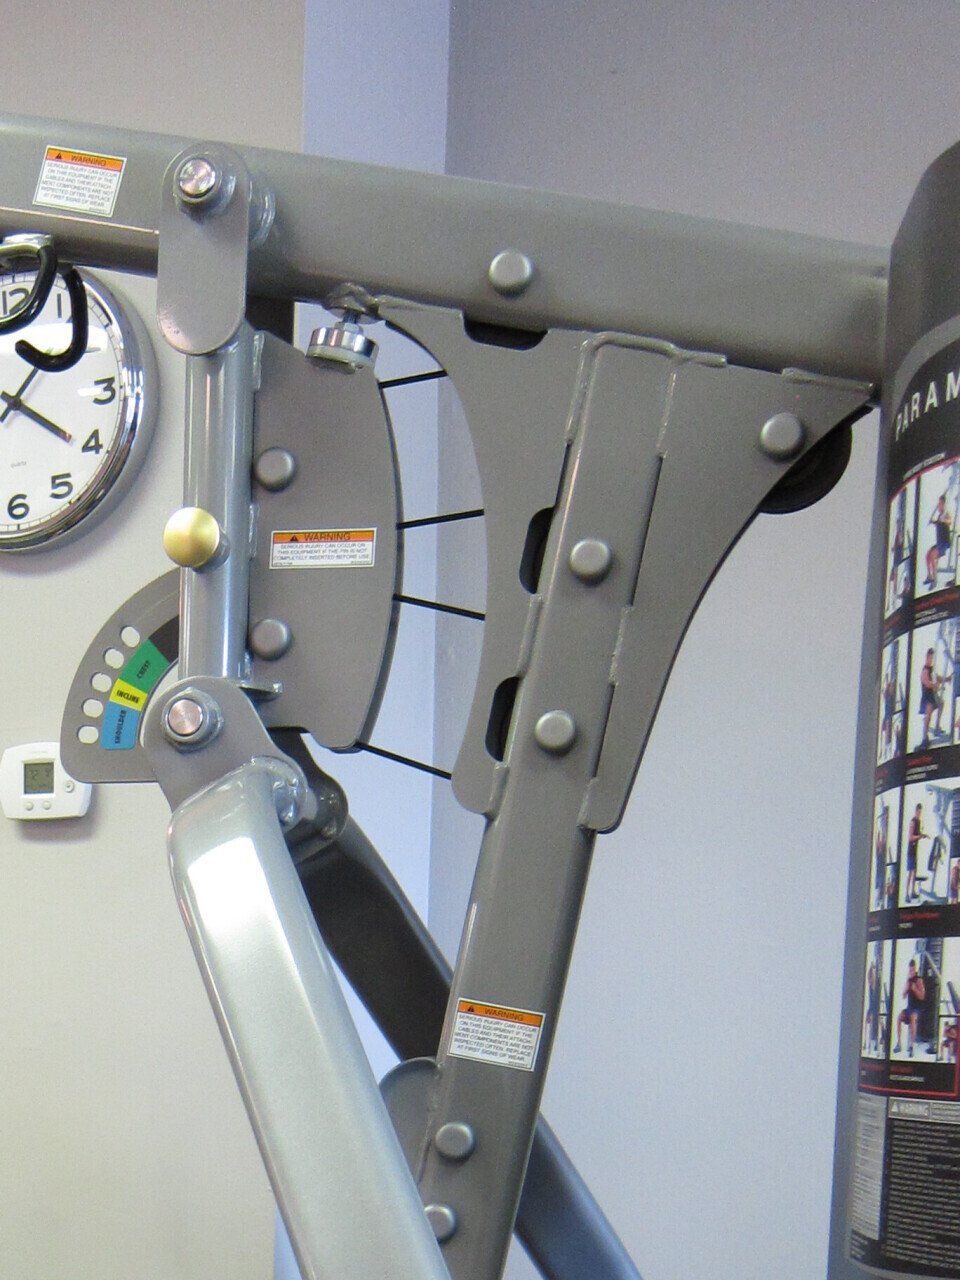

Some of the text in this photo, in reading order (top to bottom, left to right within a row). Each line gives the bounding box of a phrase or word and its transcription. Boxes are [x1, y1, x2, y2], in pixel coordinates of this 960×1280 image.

[71, 155, 106, 166] WARNING
[2, 288, 31, 316] 12
[93, 377, 115, 405] 3
[81, 429, 103, 454] 4
[50, 473, 73, 499] 5
[7, 494, 29, 519] 6
[305, 532, 350, 541] WARNING
[116, 689, 140, 704] INCLINE
[485, 1008, 524, 1021] WARNING
